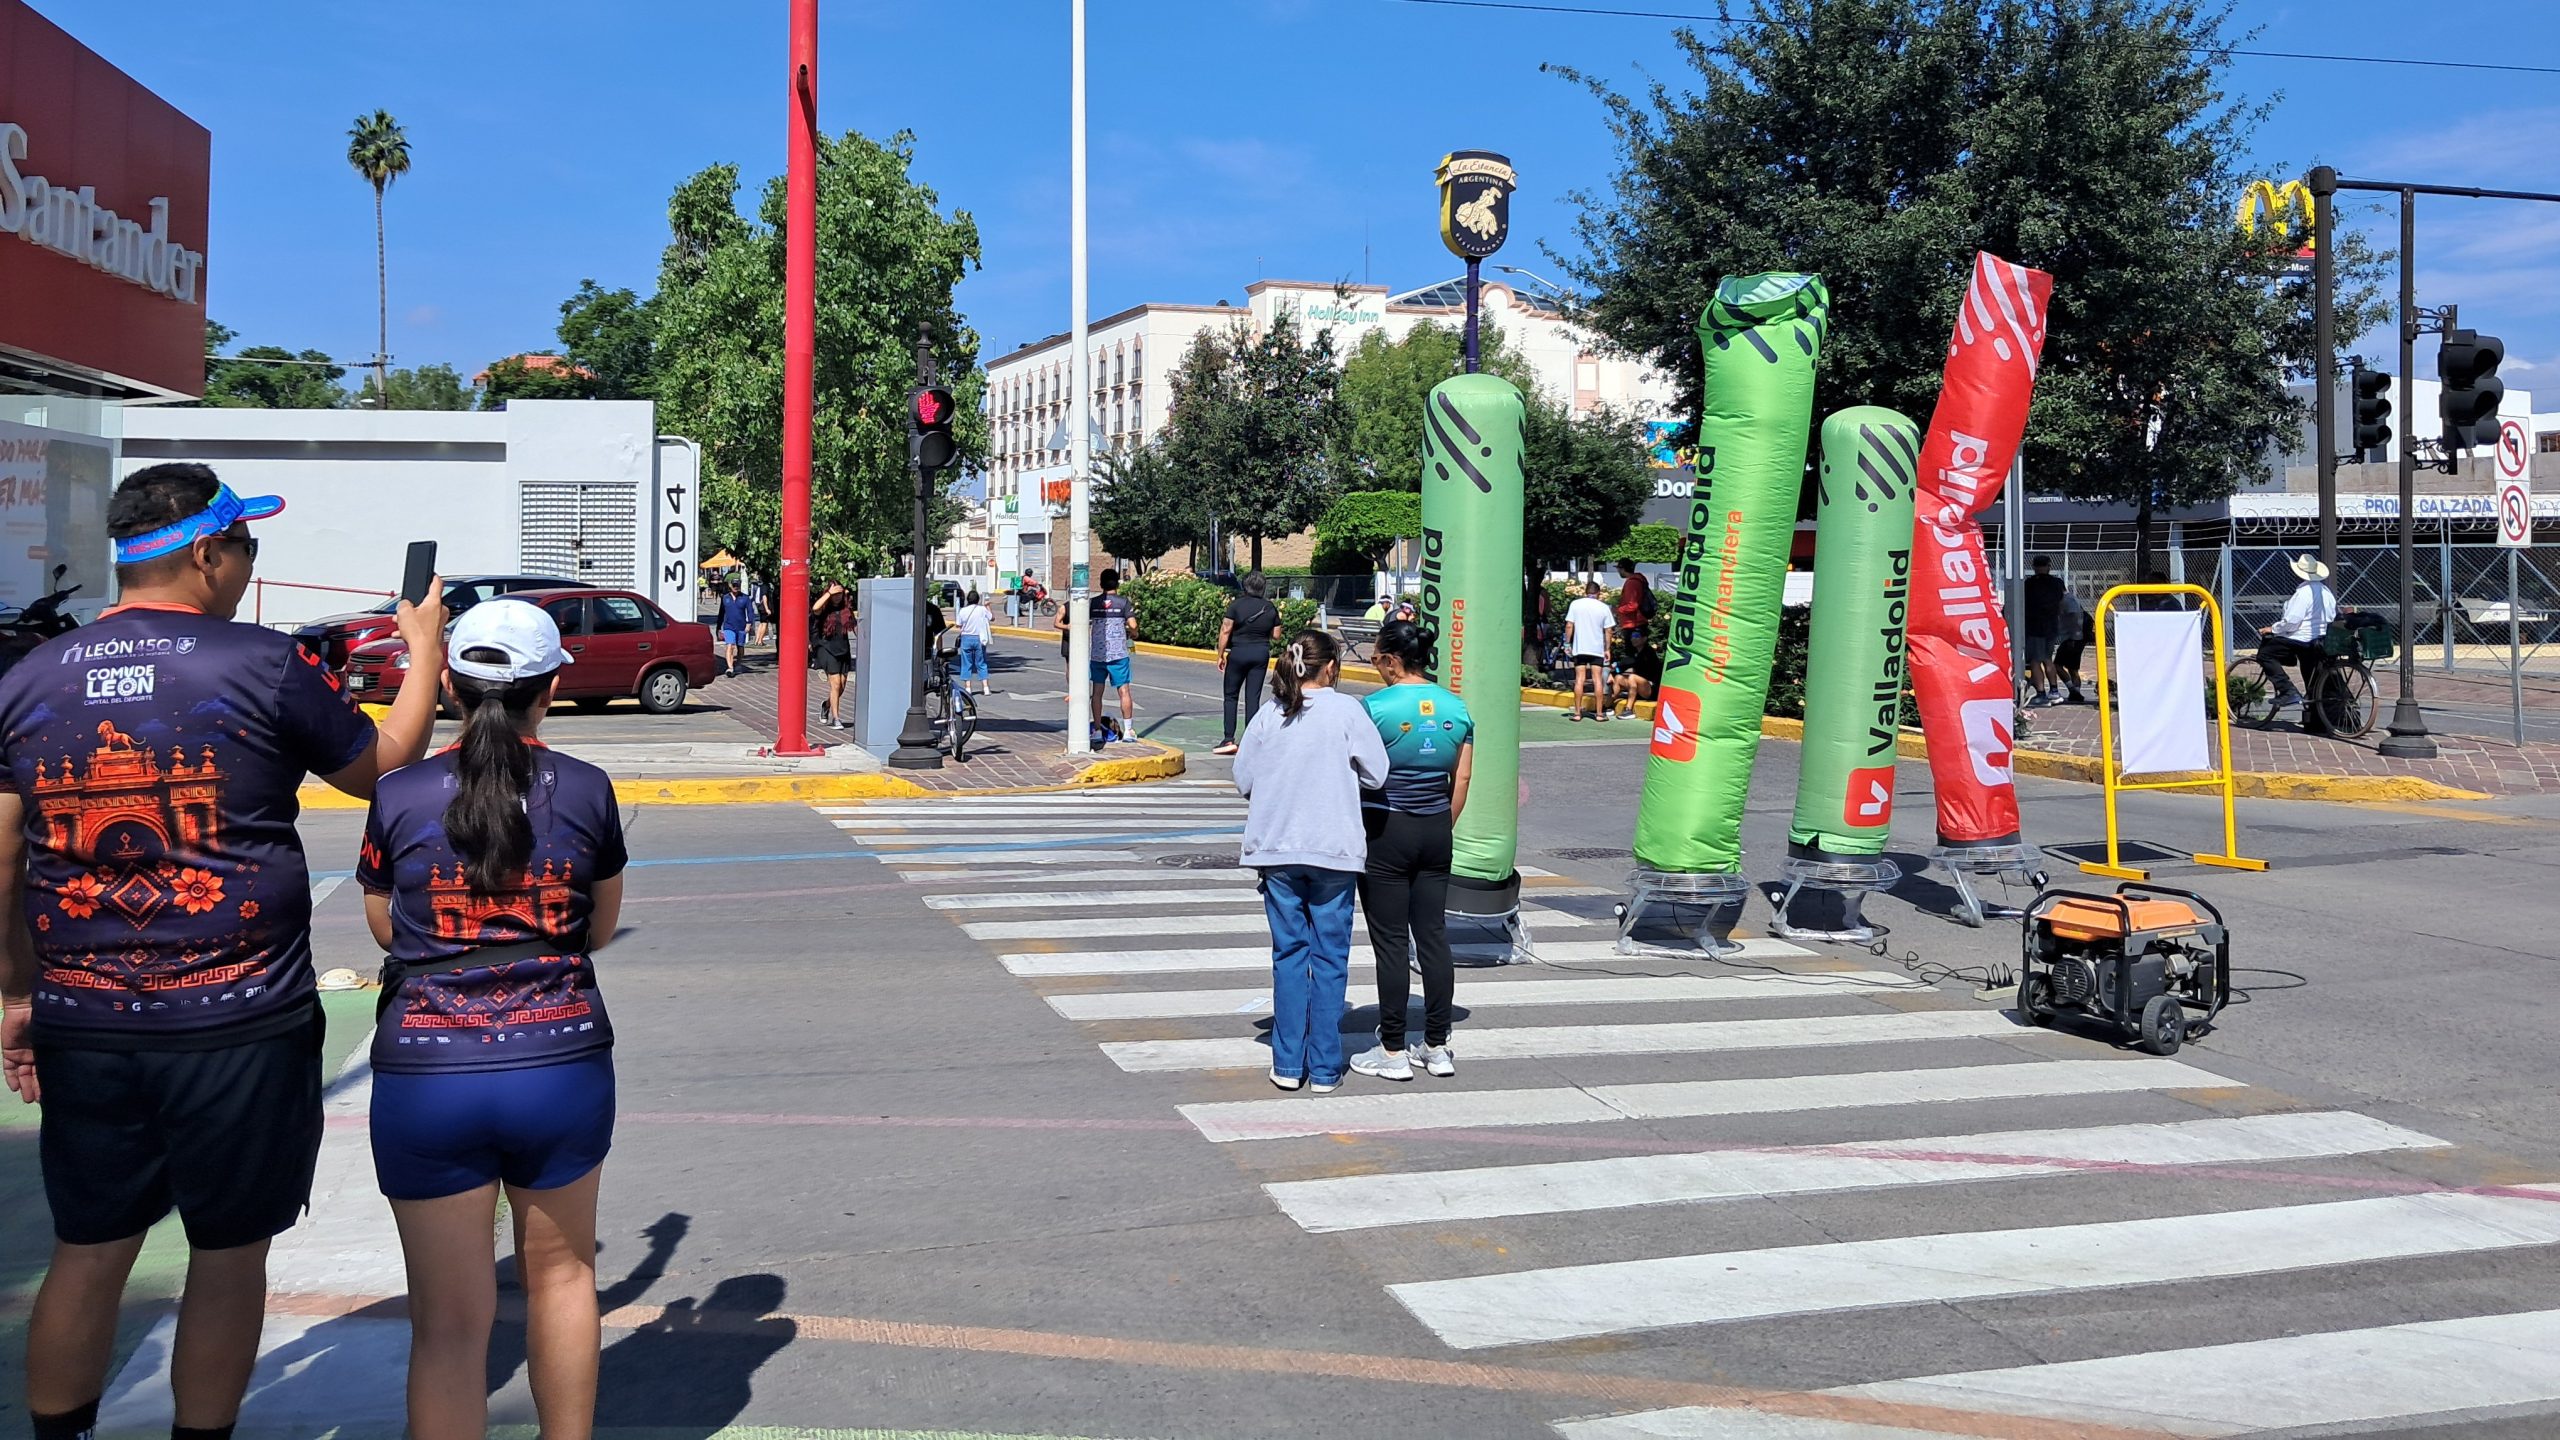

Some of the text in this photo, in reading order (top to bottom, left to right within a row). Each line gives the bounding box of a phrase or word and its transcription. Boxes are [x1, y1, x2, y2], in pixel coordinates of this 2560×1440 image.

[1470, 160, 1509, 176] Estancia
[1458, 176, 1503, 188] ARGENTINA
[0, 122, 203, 305] Santander
[1308, 305, 1380, 325] Holiday Inn
[2419, 499, 2493, 513] CALZADA
[664, 483, 686, 592] 304
[1665, 445, 1716, 673] Valladolid
[1919, 430, 2000, 684] Valladolid
[1711, 510, 1743, 629] Financiera
[85, 638, 134, 658] LEÓN
[1867, 549, 1910, 757] Valladolid
[84, 698, 109, 706] CAPITAL
[124, 694, 153, 703] DEPORTE
[579, 1021, 593, 1032] am
